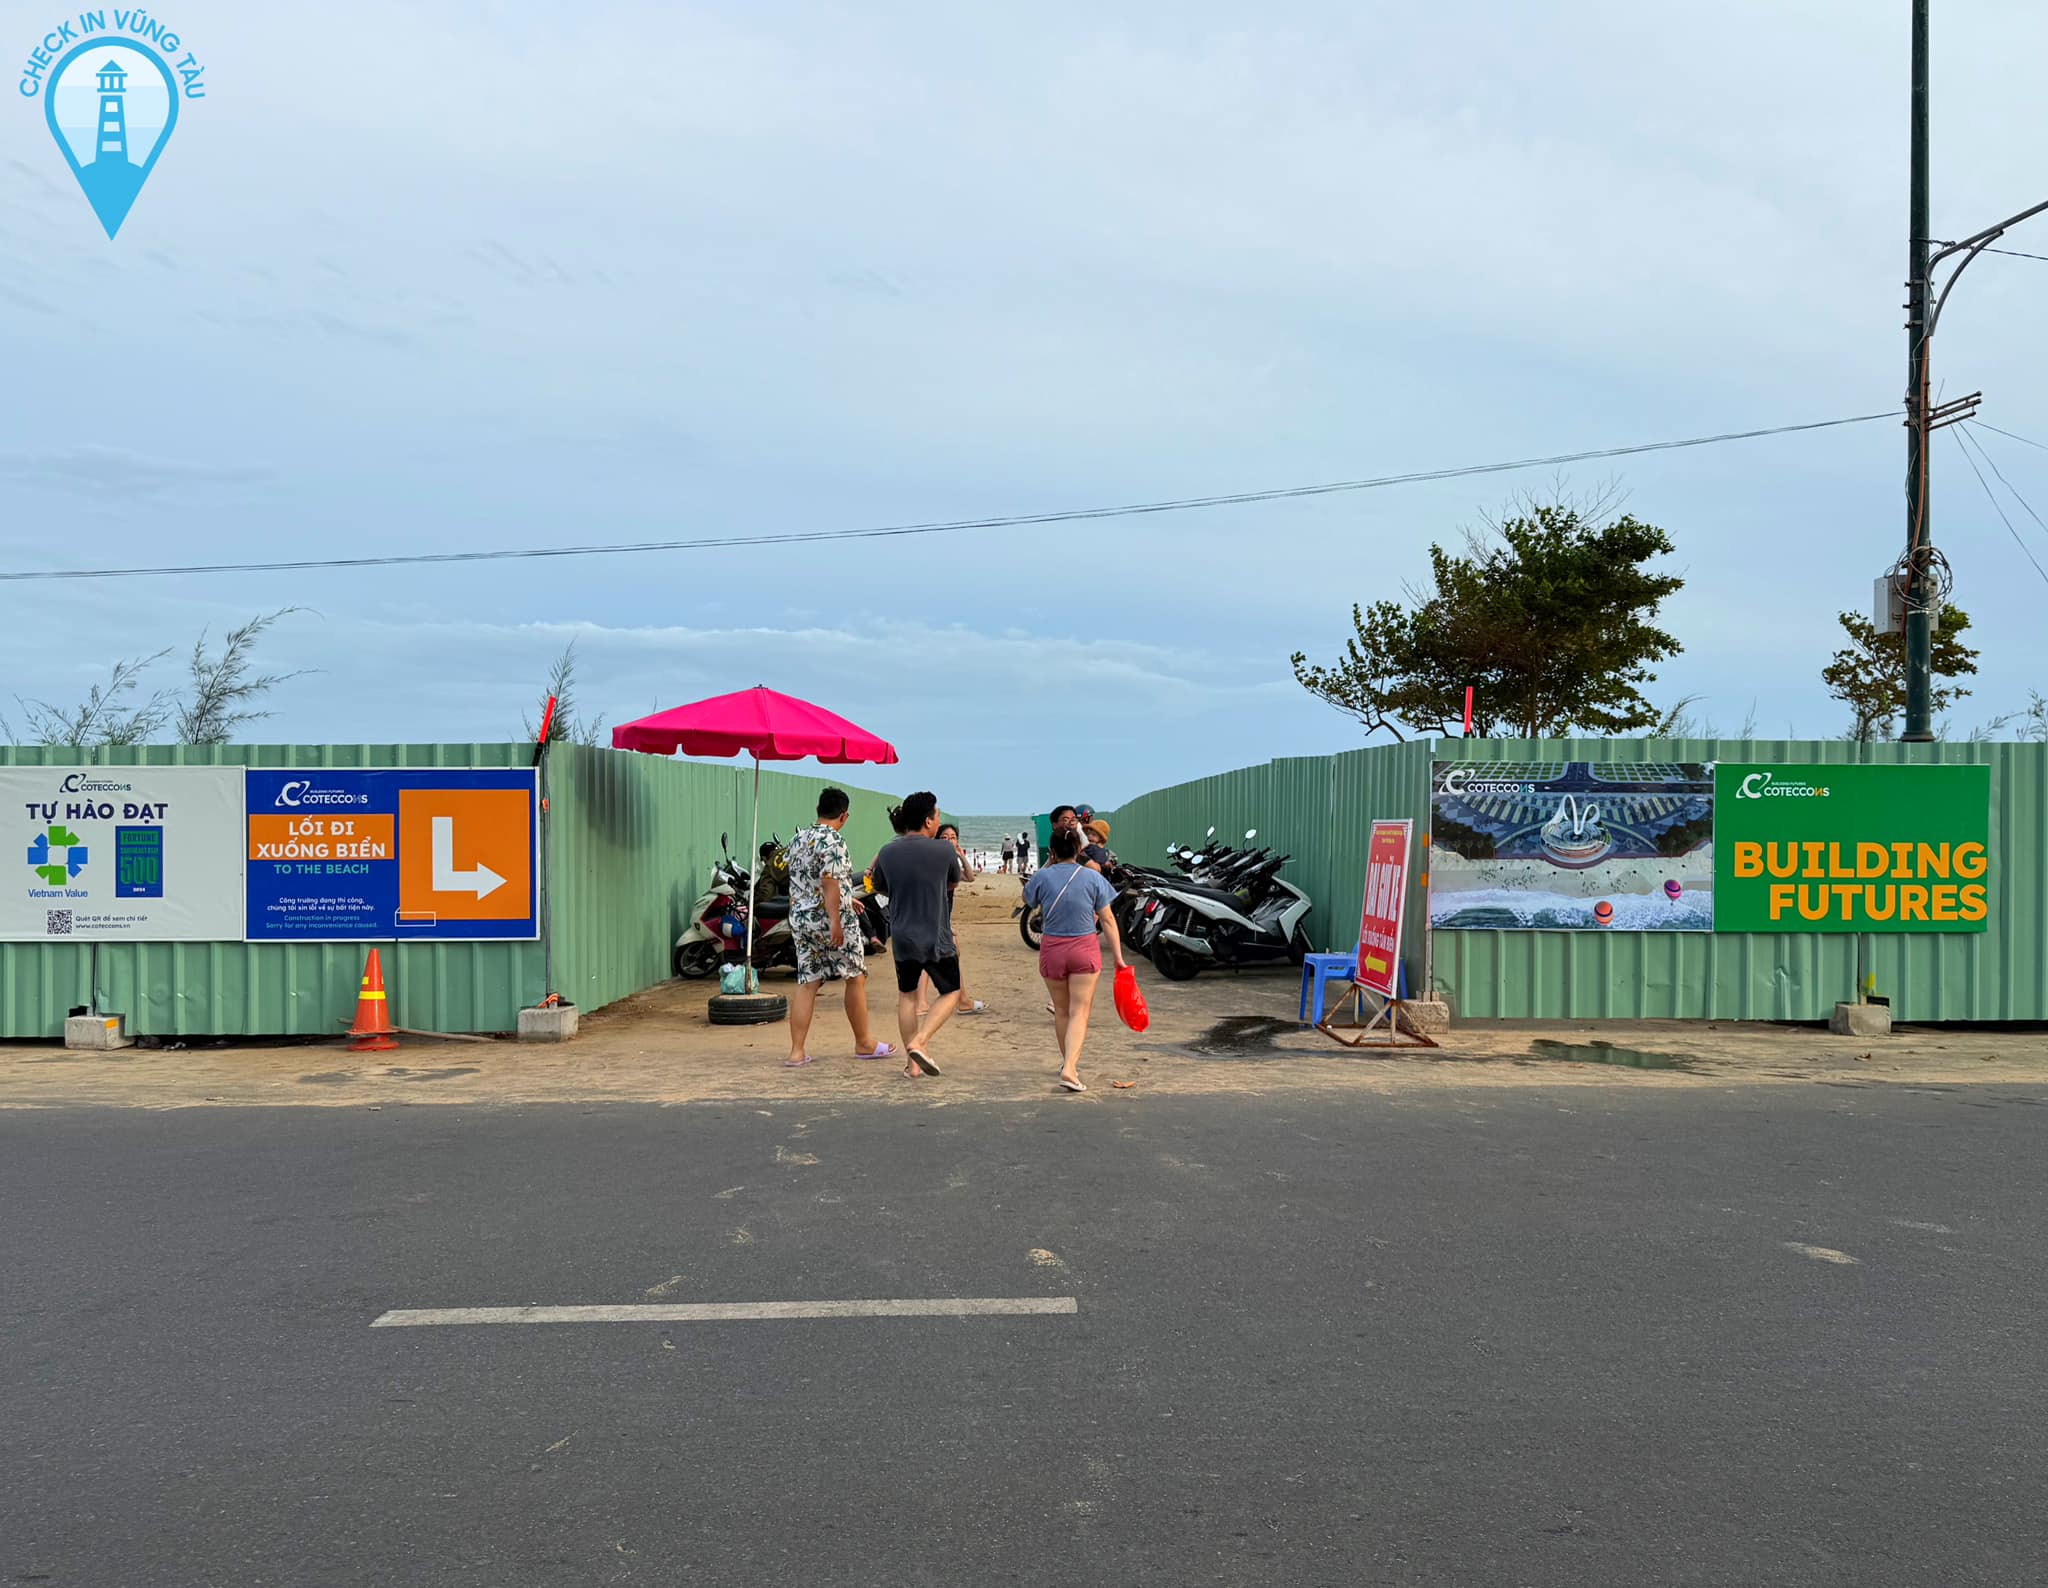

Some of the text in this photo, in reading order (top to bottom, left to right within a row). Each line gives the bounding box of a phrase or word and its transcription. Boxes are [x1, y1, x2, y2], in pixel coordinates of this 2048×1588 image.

[26, 798, 168, 824] TỰ HÀO ĐẠT
[289, 815, 354, 836] LỐI ĐI
[257, 836, 385, 858] XUỐNG BIỂN
[120, 857, 158, 885] 500
[274, 864, 369, 874] TO THE BEACH
[1734, 841, 1988, 879] BUILDING
[28, 889, 88, 898] Vietnam Value
[1770, 884, 1988, 921] FUTURES
